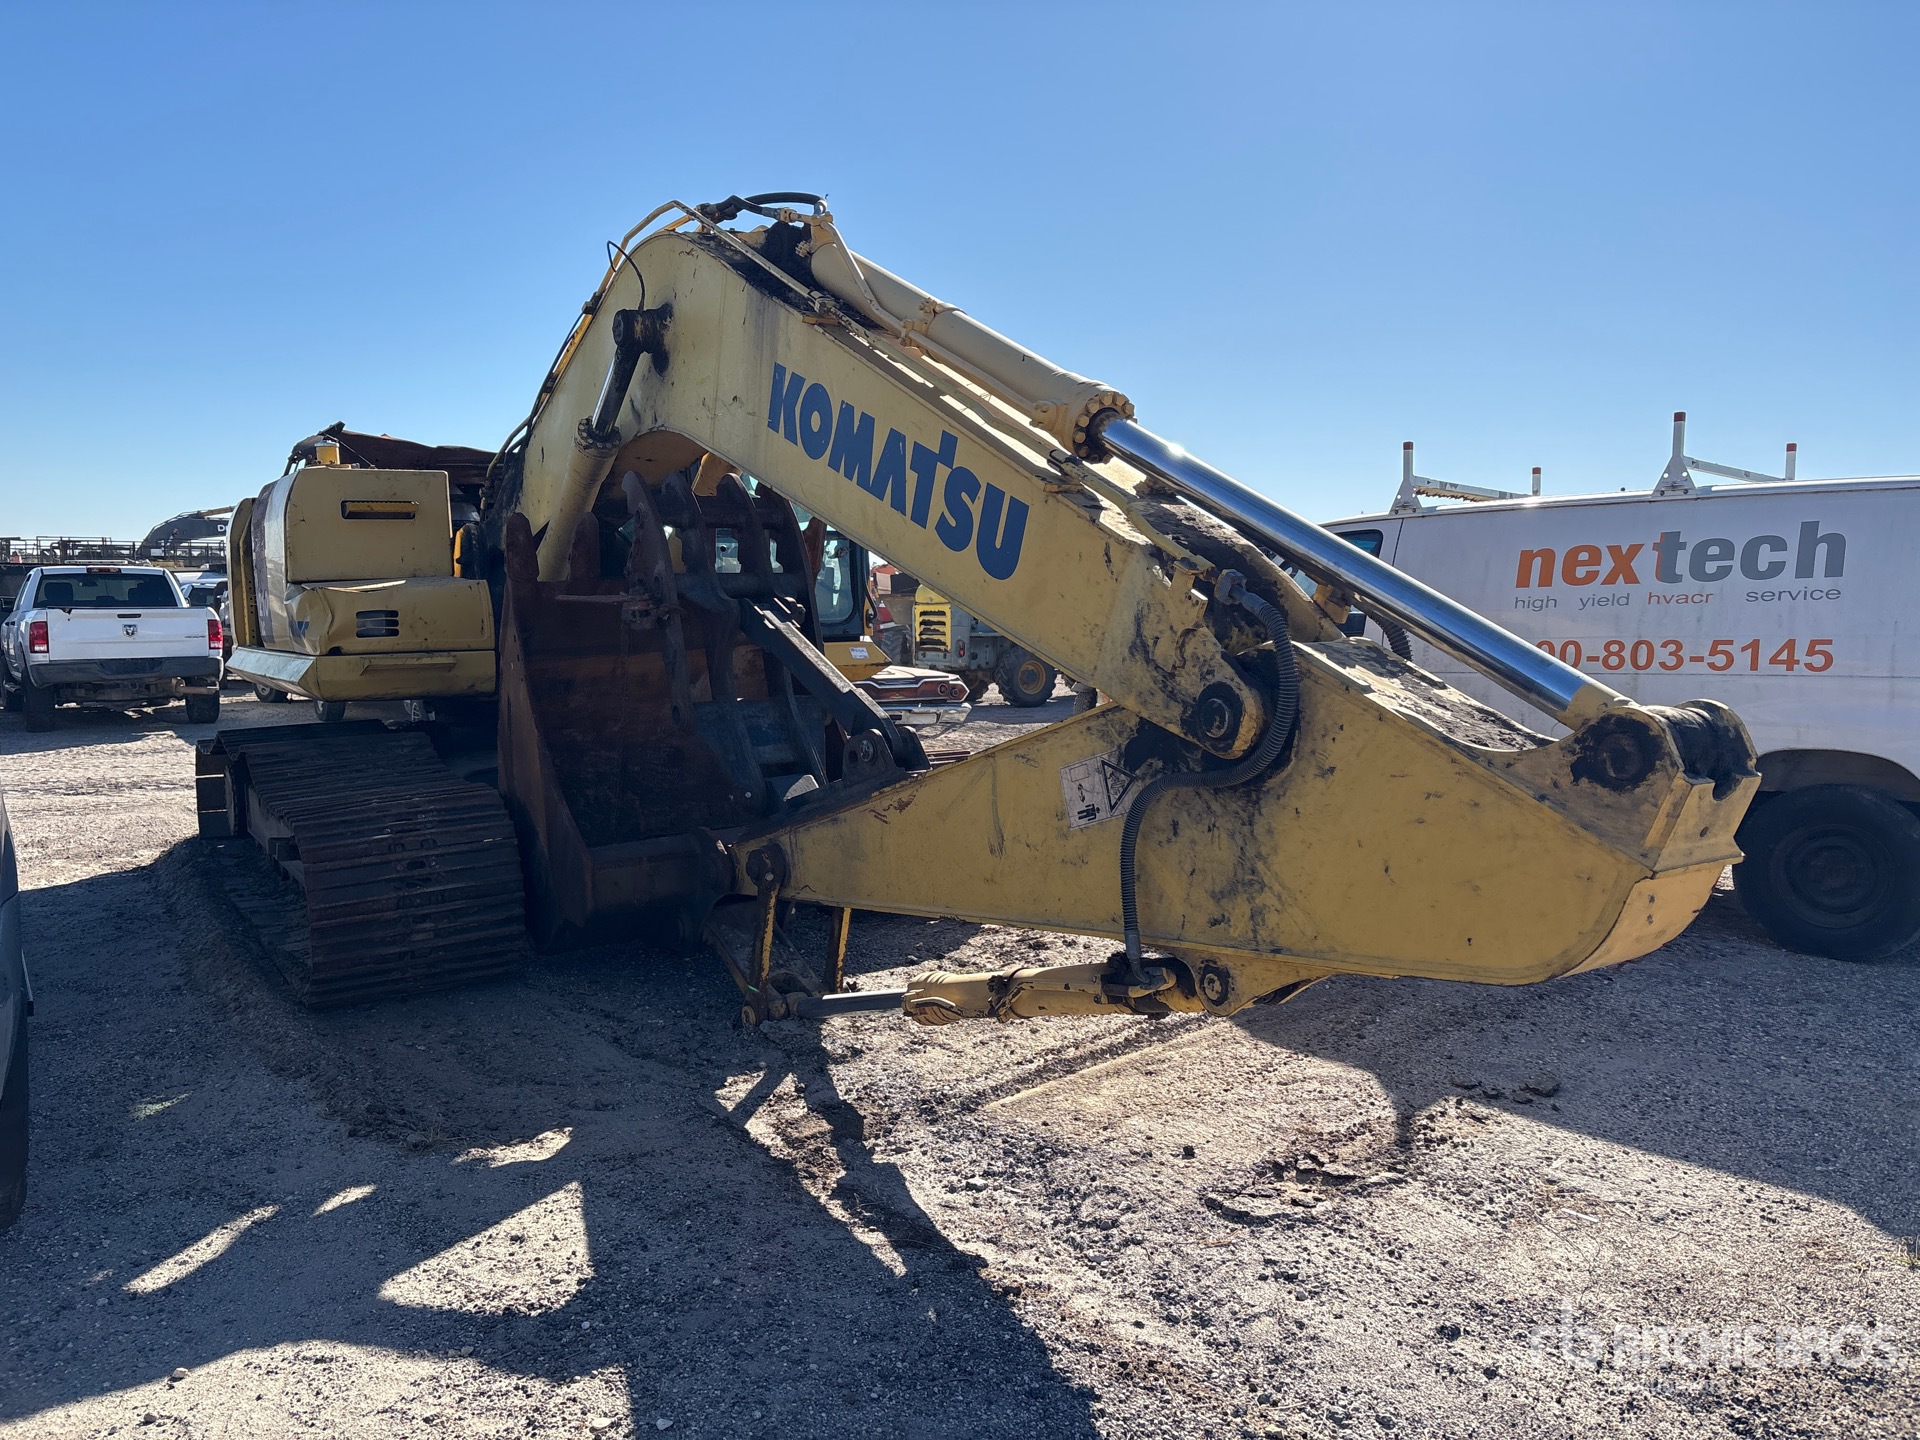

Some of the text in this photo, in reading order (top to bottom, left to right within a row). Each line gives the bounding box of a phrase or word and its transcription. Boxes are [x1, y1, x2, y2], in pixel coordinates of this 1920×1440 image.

[767, 362, 1030, 580] KOMATSU
[1515, 520, 1847, 588] nextech
[1514, 586, 1842, 612] high yield hvacr service
